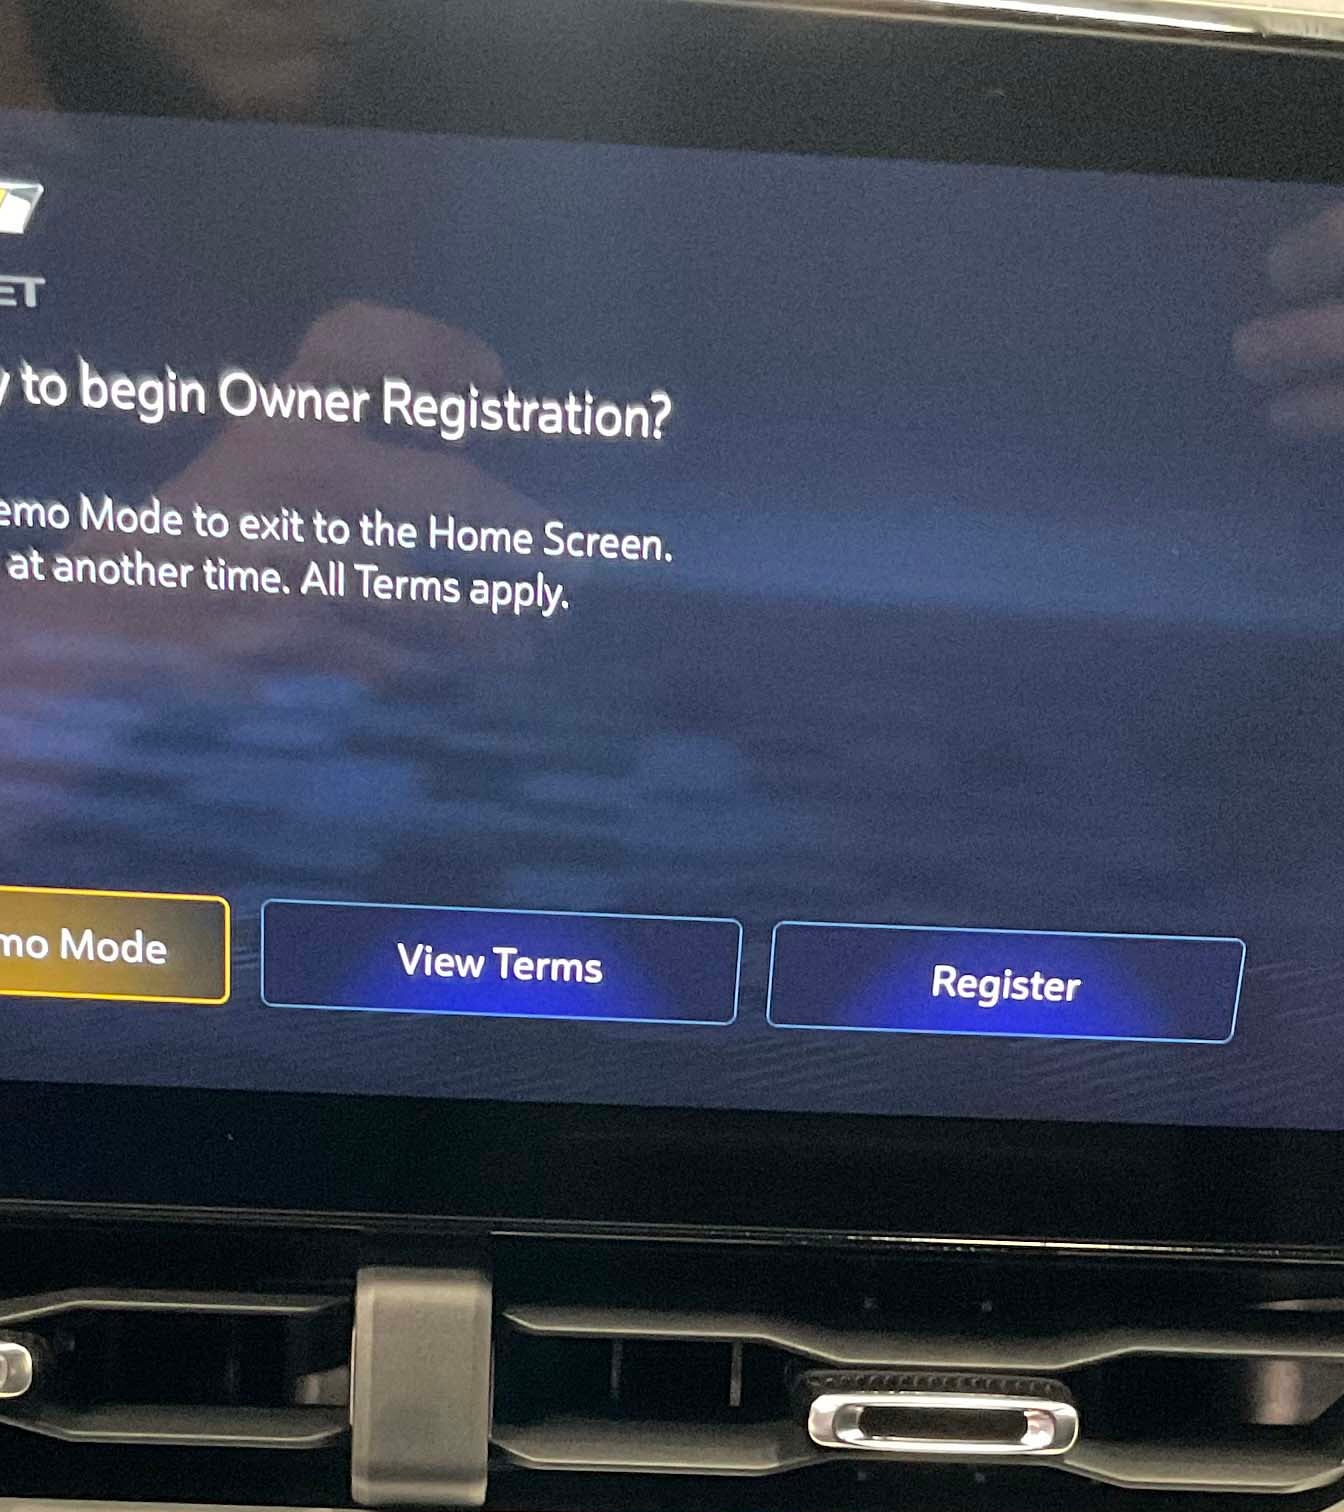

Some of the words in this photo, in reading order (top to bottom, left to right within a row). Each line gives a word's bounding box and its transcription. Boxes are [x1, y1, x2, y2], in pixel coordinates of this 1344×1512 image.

[21, 360, 68, 407] to
[78, 354, 207, 424] begin
[219, 369, 371, 423] Owner
[383, 378, 672, 441] Registration?
[80, 493, 184, 537] Mode
[193, 503, 230, 538] to
[239, 507, 305, 543] exit
[313, 509, 350, 545] to
[359, 509, 418, 549] the
[429, 513, 534, 555] Home
[543, 520, 673, 563] Screen.
[7, 547, 45, 581] at
[53, 549, 194, 589] another
[203, 557, 291, 595] time.
[300, 560, 346, 597] All
[354, 563, 462, 604] Terms
[469, 570, 570, 618] apply.
[60, 928, 168, 965] Mode
[397, 942, 486, 978] View
[492, 946, 604, 984] Terms
[931, 964, 1082, 1008] Register
